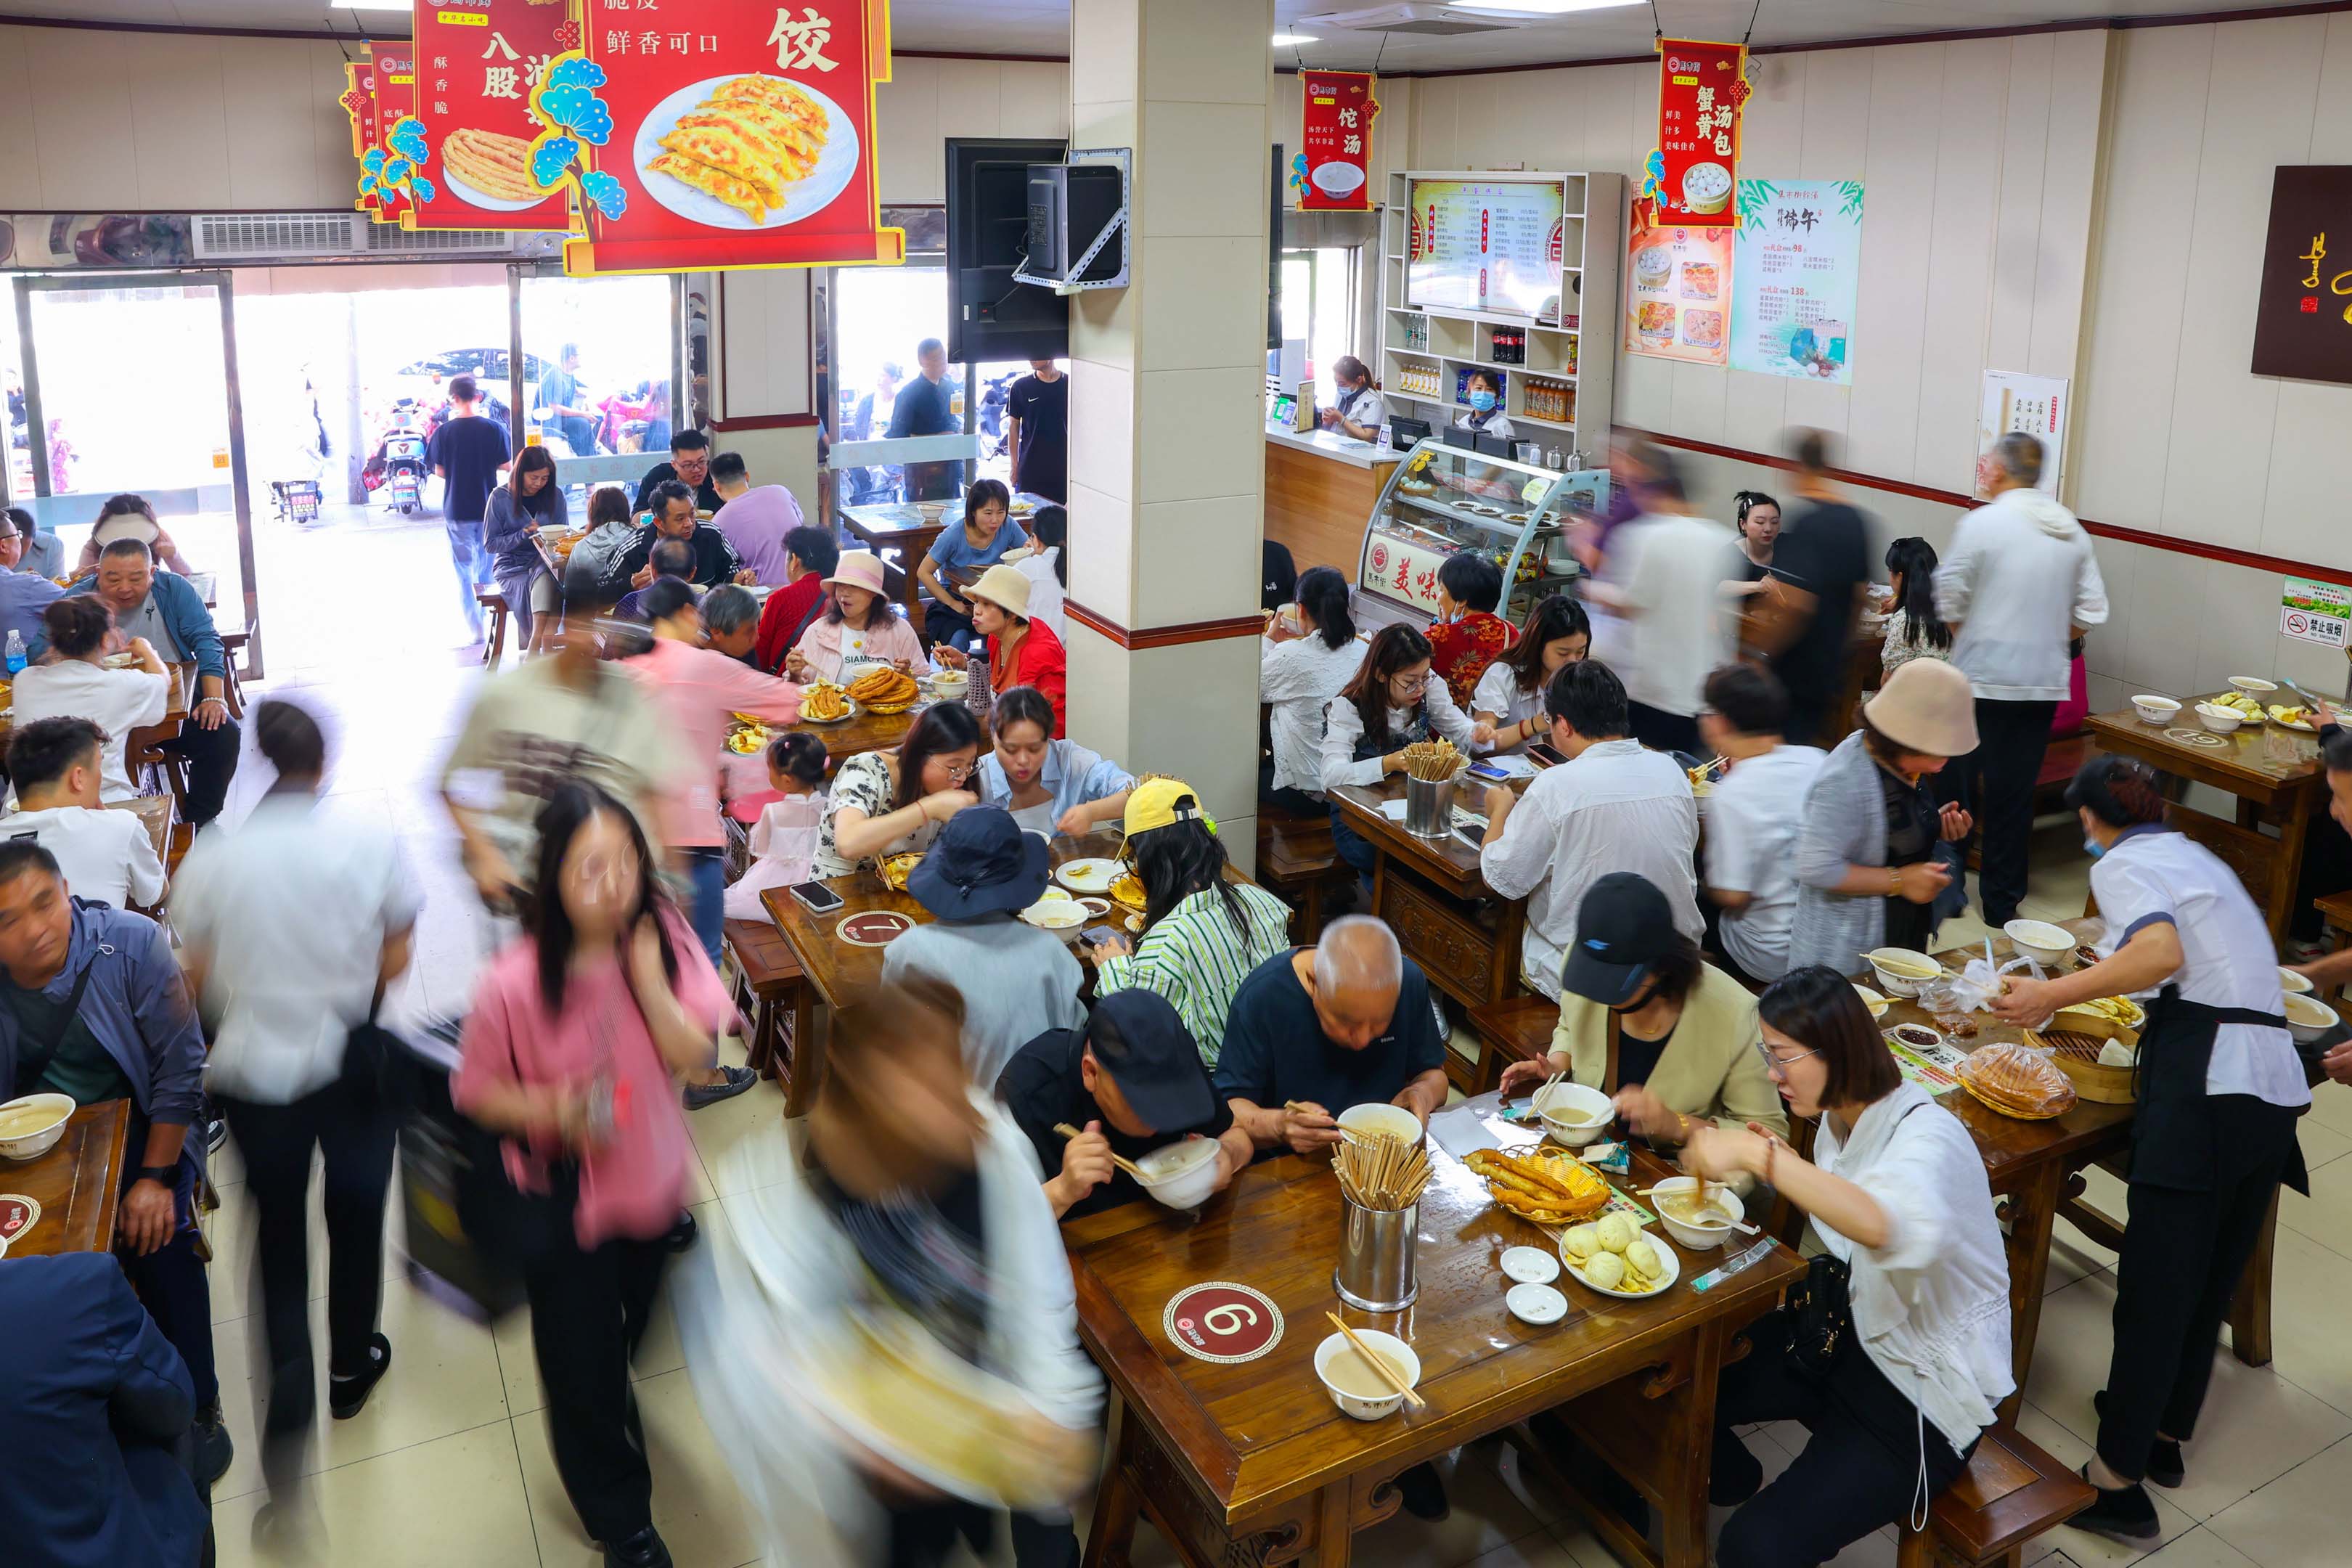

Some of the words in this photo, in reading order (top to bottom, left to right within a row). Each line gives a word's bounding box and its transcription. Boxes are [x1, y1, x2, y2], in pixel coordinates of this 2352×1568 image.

[605, 30, 719, 55] 鲜香可口
[767, 7, 840, 73] 饺
[481, 32, 522, 99] 八股
[434, 56, 449, 115] 酥香脆
[1666, 110, 1681, 120] 鲜美
[1696, 85, 1715, 139] 蟹黄
[1665, 126, 1681, 135] 汁多
[1713, 105, 1733, 156] 汤包
[1784, 208, 1819, 234] 端午
[1790, 287, 1804, 295] 138
[1392, 556, 1437, 601] 美味
[2310, 618, 2343, 637] 禁止吸烟
[1204, 1304, 1258, 1335] 6
